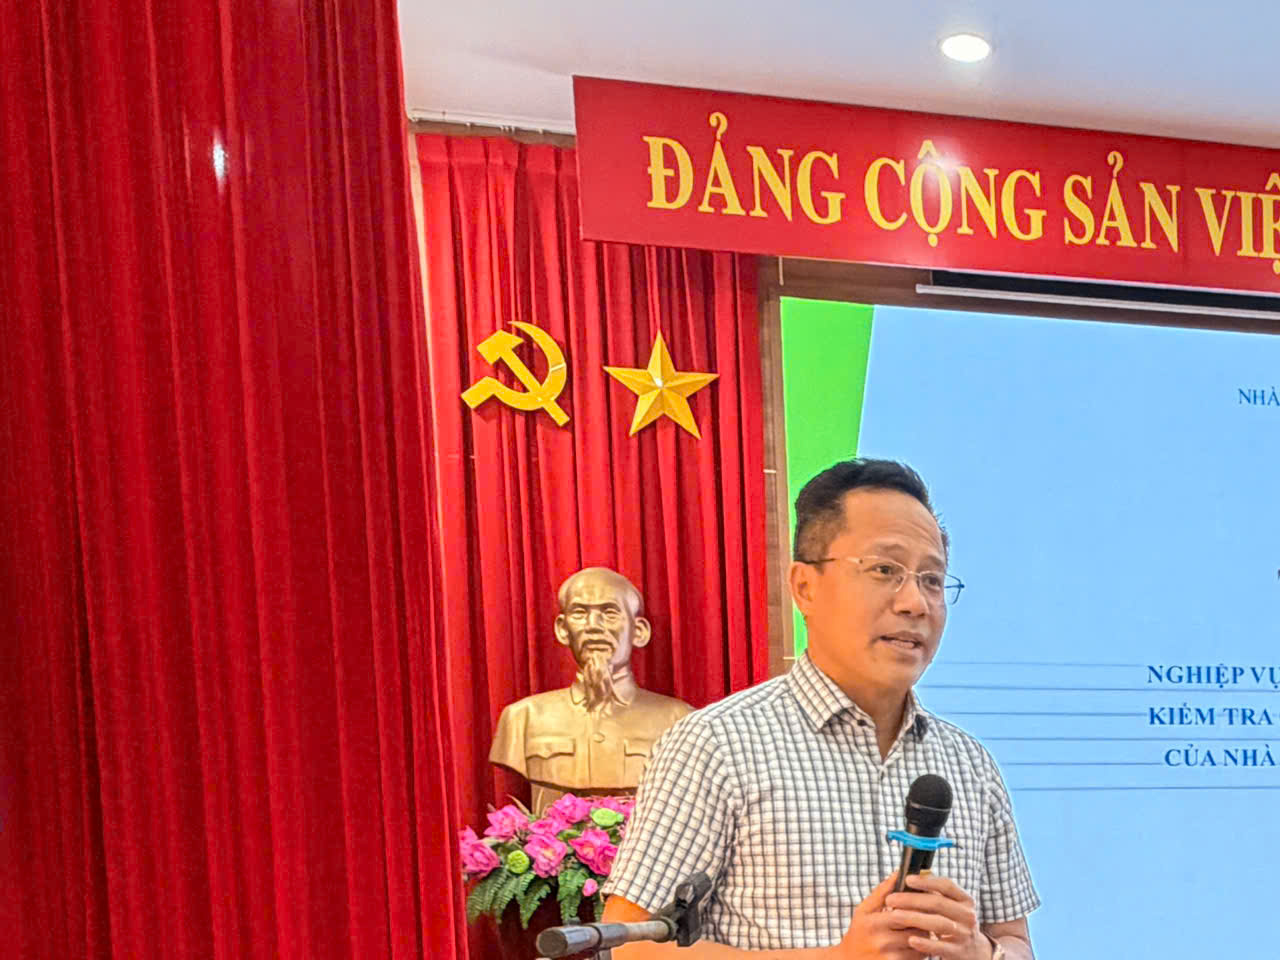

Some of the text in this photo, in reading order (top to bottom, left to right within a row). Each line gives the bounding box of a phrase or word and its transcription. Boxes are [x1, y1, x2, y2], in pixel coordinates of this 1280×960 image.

[643, 112, 846, 225] ĐẢNG
[864, 140, 1046, 247] CỘNG
[1063, 150, 1180, 253] SẢN
[1238, 386, 1280, 407] NHÀ
[1147, 663, 1245, 689] NGHIỆP
[1223, 707, 1273, 725] TRA
[1164, 743, 1217, 767] CỦA
[1223, 743, 1276, 767] NHÀ
